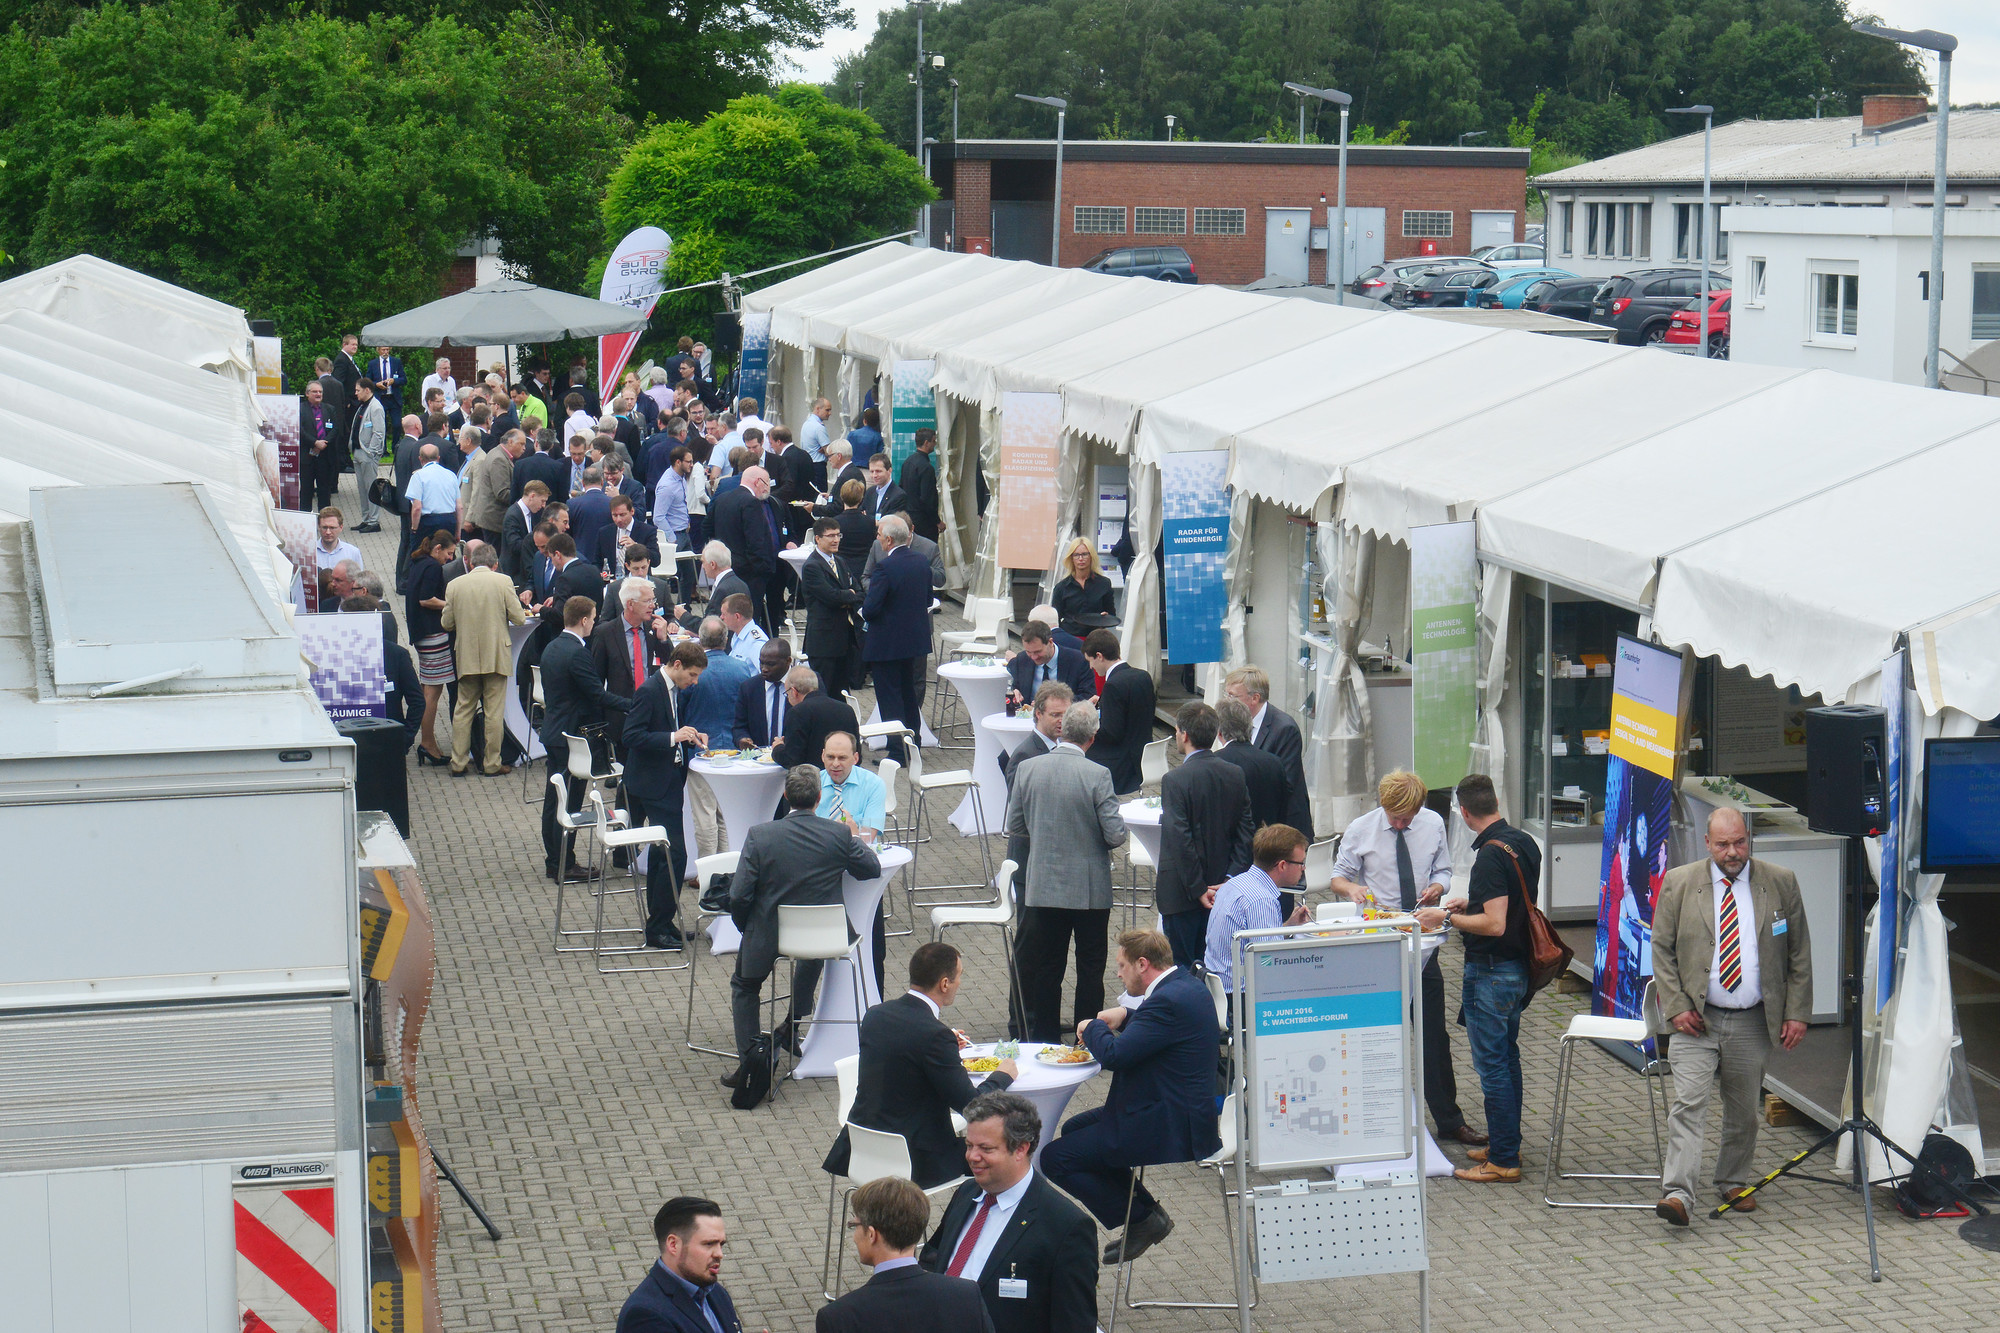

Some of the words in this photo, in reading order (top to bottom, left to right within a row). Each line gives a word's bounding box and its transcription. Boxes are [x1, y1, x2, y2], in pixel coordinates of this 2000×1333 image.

[1178, 528, 1203, 536] RADAR
[1205, 526, 1218, 535] FÜR
[1173, 535, 1223, 544] WINDENERGIE
[1425, 618, 1463, 629] ANTENNEN-
[1422, 627, 1467, 640] TECHNOLOGIE
[1635, 737, 1646, 748] AND
[1274, 954, 1324, 966] Fraunhofer
[1262, 1010, 1275, 1018] 30.
[1276, 1008, 1293, 1017] JUNI
[1294, 1007, 1313, 1015] 2016
[1262, 1019, 1270, 1027] 6.
[1271, 1013, 1348, 1026] WACHTBERG-FORUM
[243, 1168, 271, 1177] MBB
[273, 1165, 322, 1175] PALFINGER
